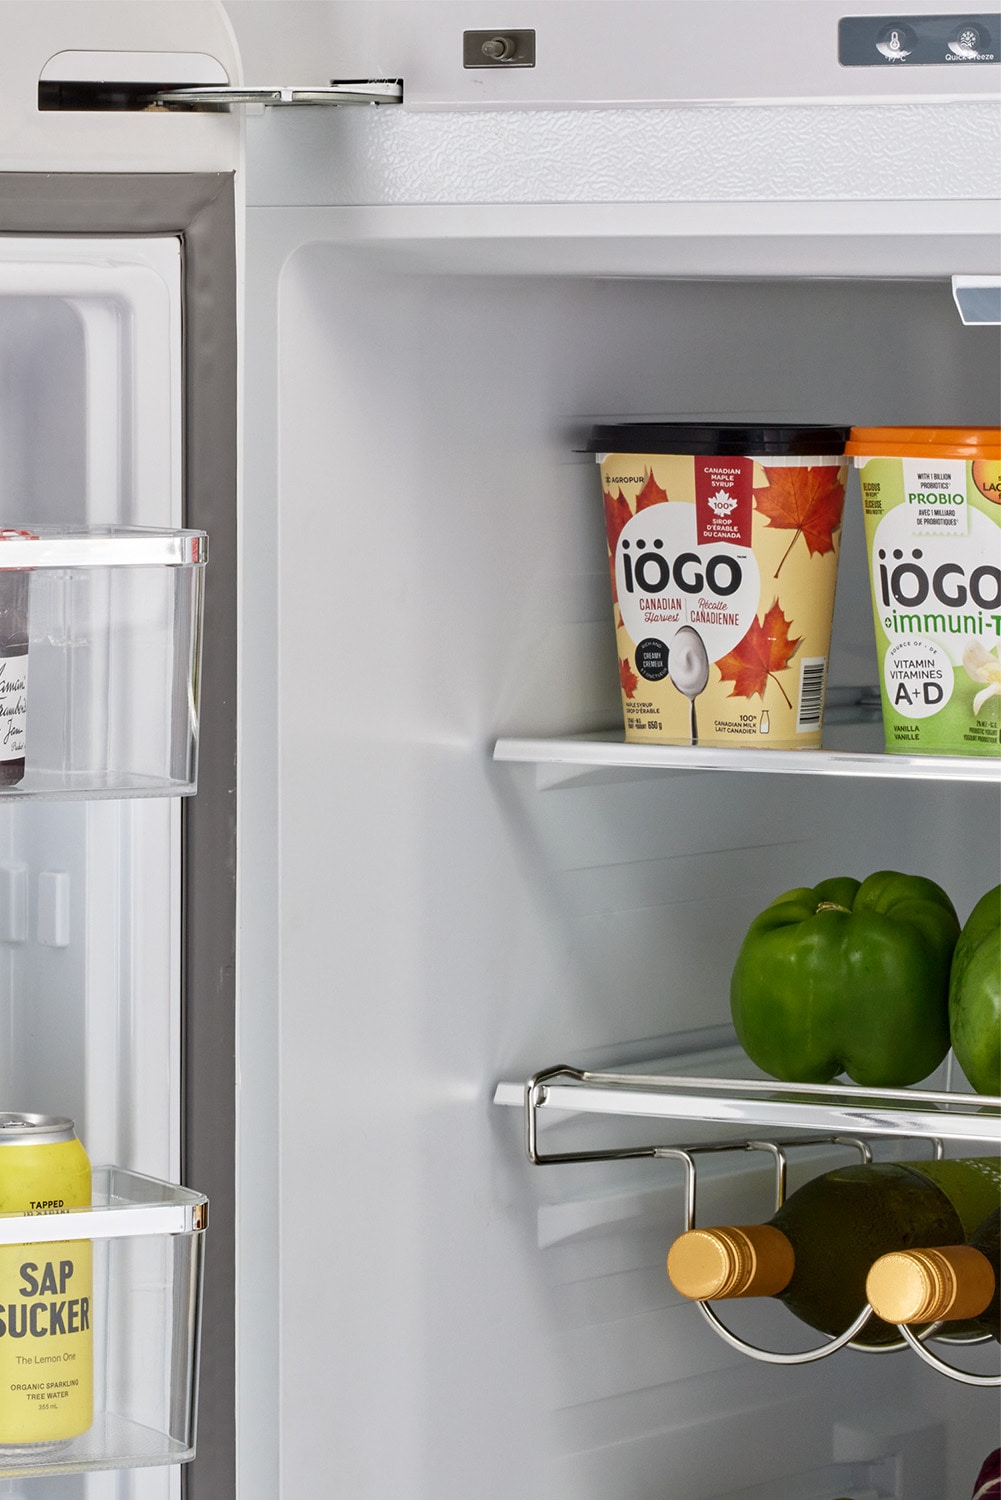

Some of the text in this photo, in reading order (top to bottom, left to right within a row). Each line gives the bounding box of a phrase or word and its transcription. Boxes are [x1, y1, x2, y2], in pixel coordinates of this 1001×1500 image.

[704, 467, 741, 475] CANADIAN
[612, 476, 644, 484] AGROPUR
[908, 493, 964, 505] PROBIO
[706, 524, 738, 532] D'ÉRABLE
[639, 598, 682, 611] CANADIAN
[698, 597, 729, 611] Récolte
[644, 612, 680, 623] Harvest
[690, 611, 739, 626] CANADIENNE
[894, 660, 935, 669] VITAMIN
[890, 670, 943, 680] VITAMINES
[895, 682, 944, 705] A+D
[714, 720, 742, 728] CANADIAN
[895, 733, 920, 741] VANILLE
[29, 1200, 64, 1210] TAPPED
[19, 1260, 74, 1298] SAP
[16, 1352, 76, 1365] The Lemon One
[10, 1379, 79, 1391] ORGANIC SPARKLING
[47, 1391, 69, 1399] WATER
